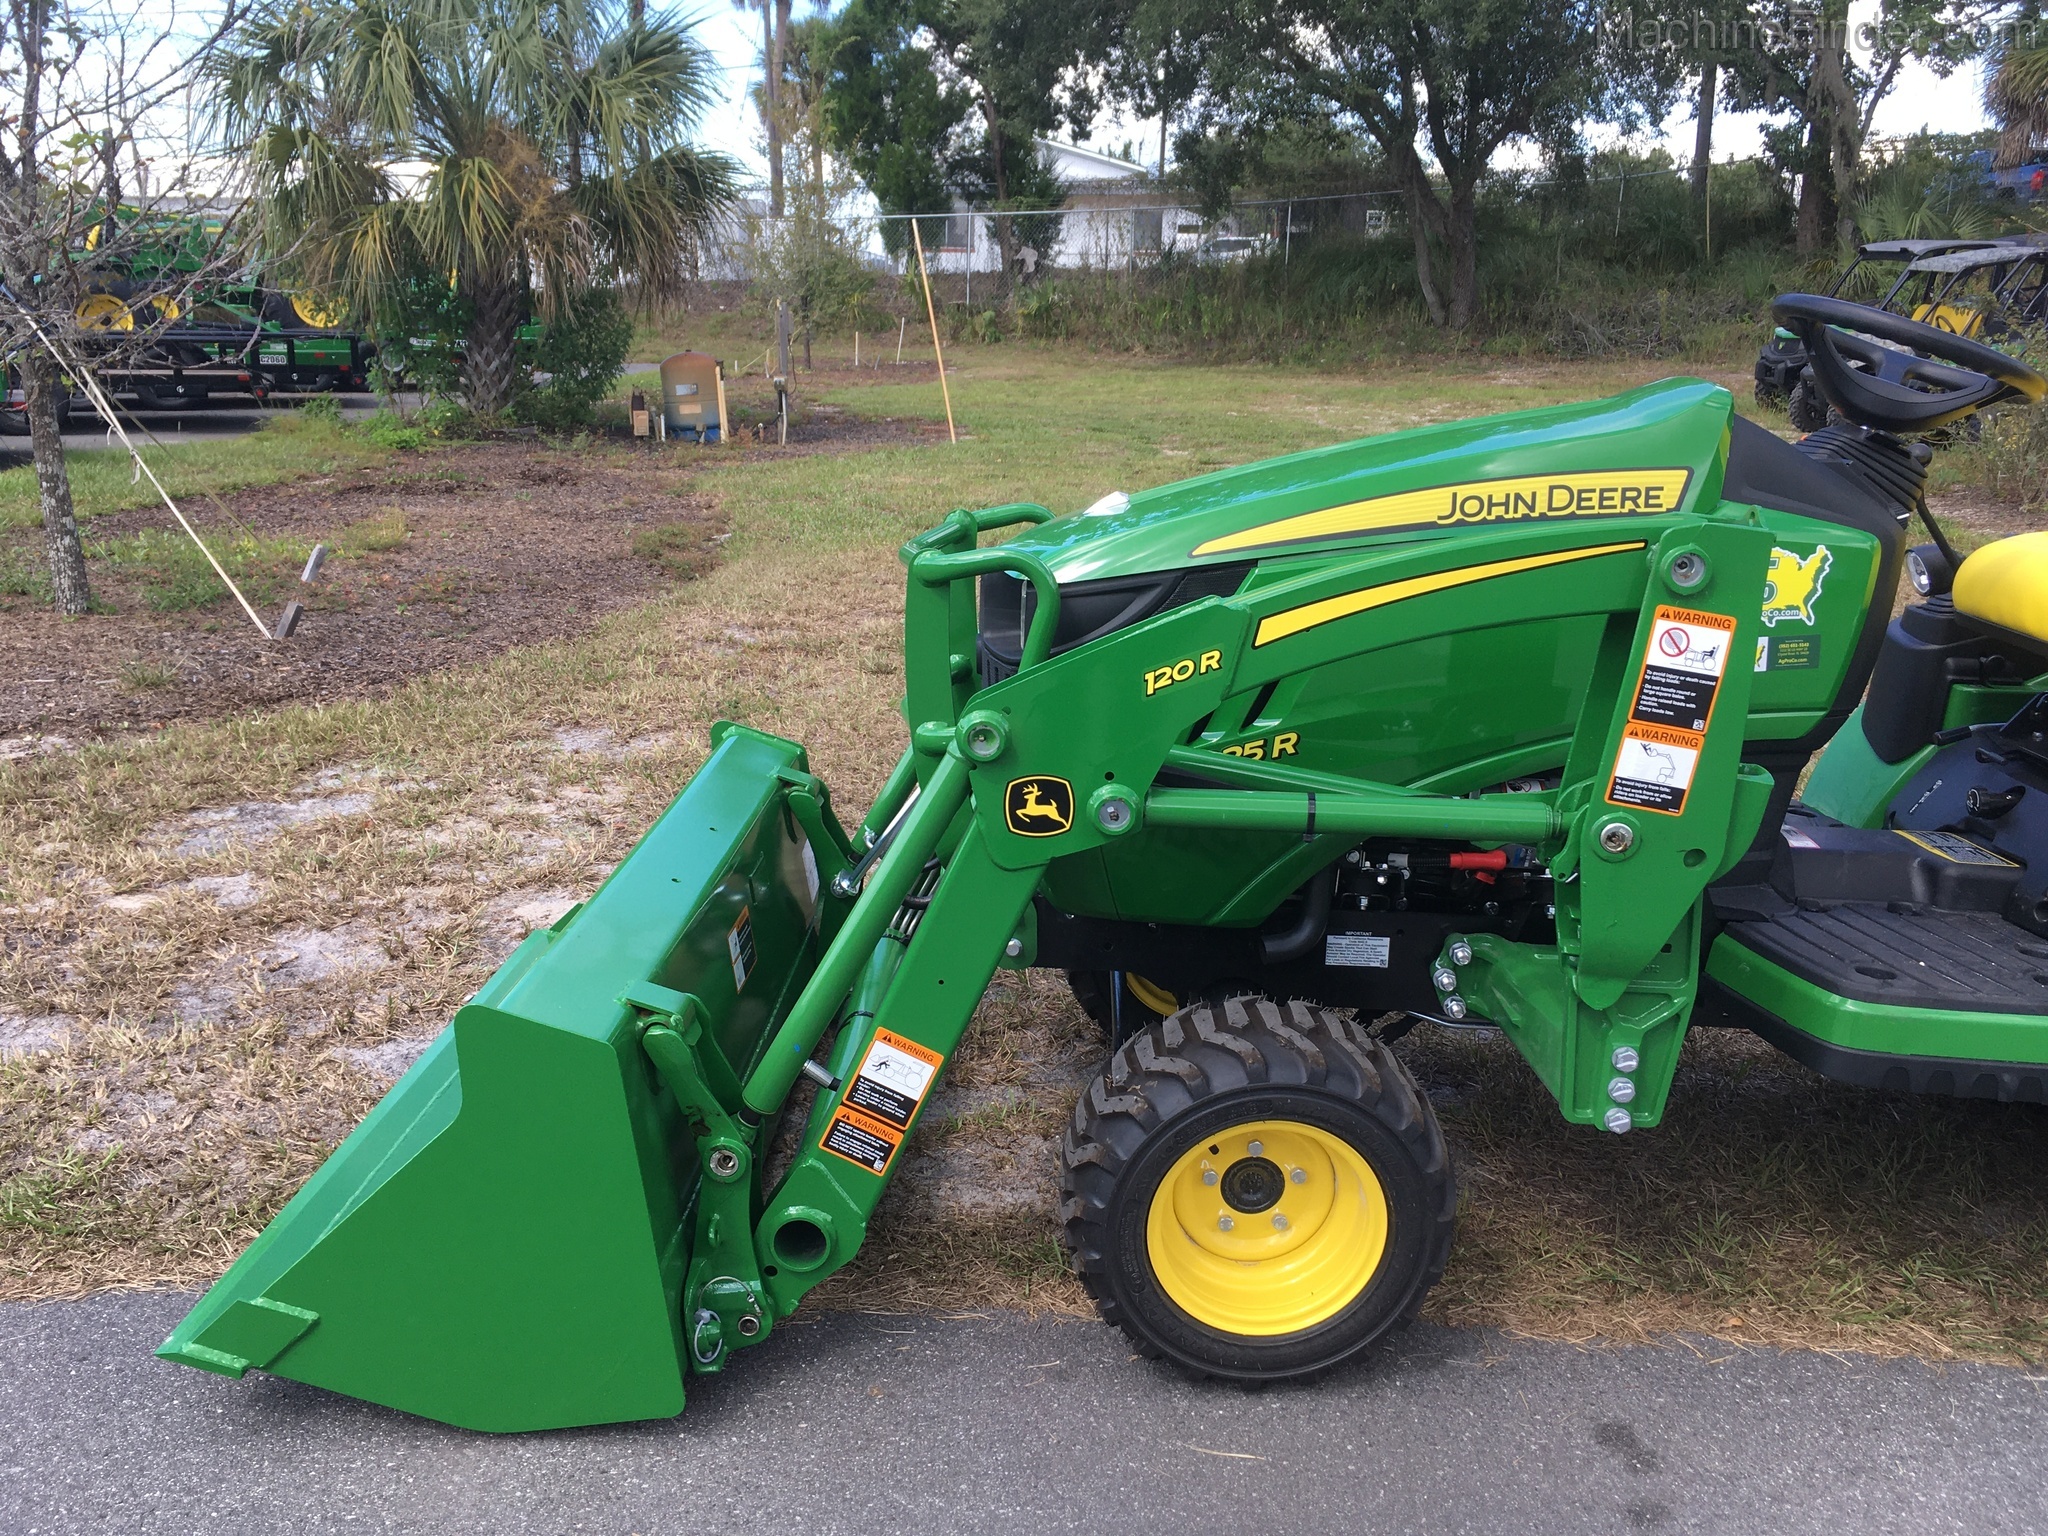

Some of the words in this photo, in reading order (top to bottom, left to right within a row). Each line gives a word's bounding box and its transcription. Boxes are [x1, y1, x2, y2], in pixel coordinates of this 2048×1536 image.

[1437, 491, 1537, 521] JOHN
[1547, 484, 1664, 512] DEERE
[1673, 610, 1732, 629] WARNING
[1762, 608, 1799, 616] oCo.com
[1144, 658, 1196, 697] 120
[1199, 648, 1222, 676] R
[1271, 731, 1300, 759] R
[1641, 729, 1699, 747] WARNING
[894, 1038, 934, 1062] WARNING
[854, 1116, 894, 1140] WARNING
